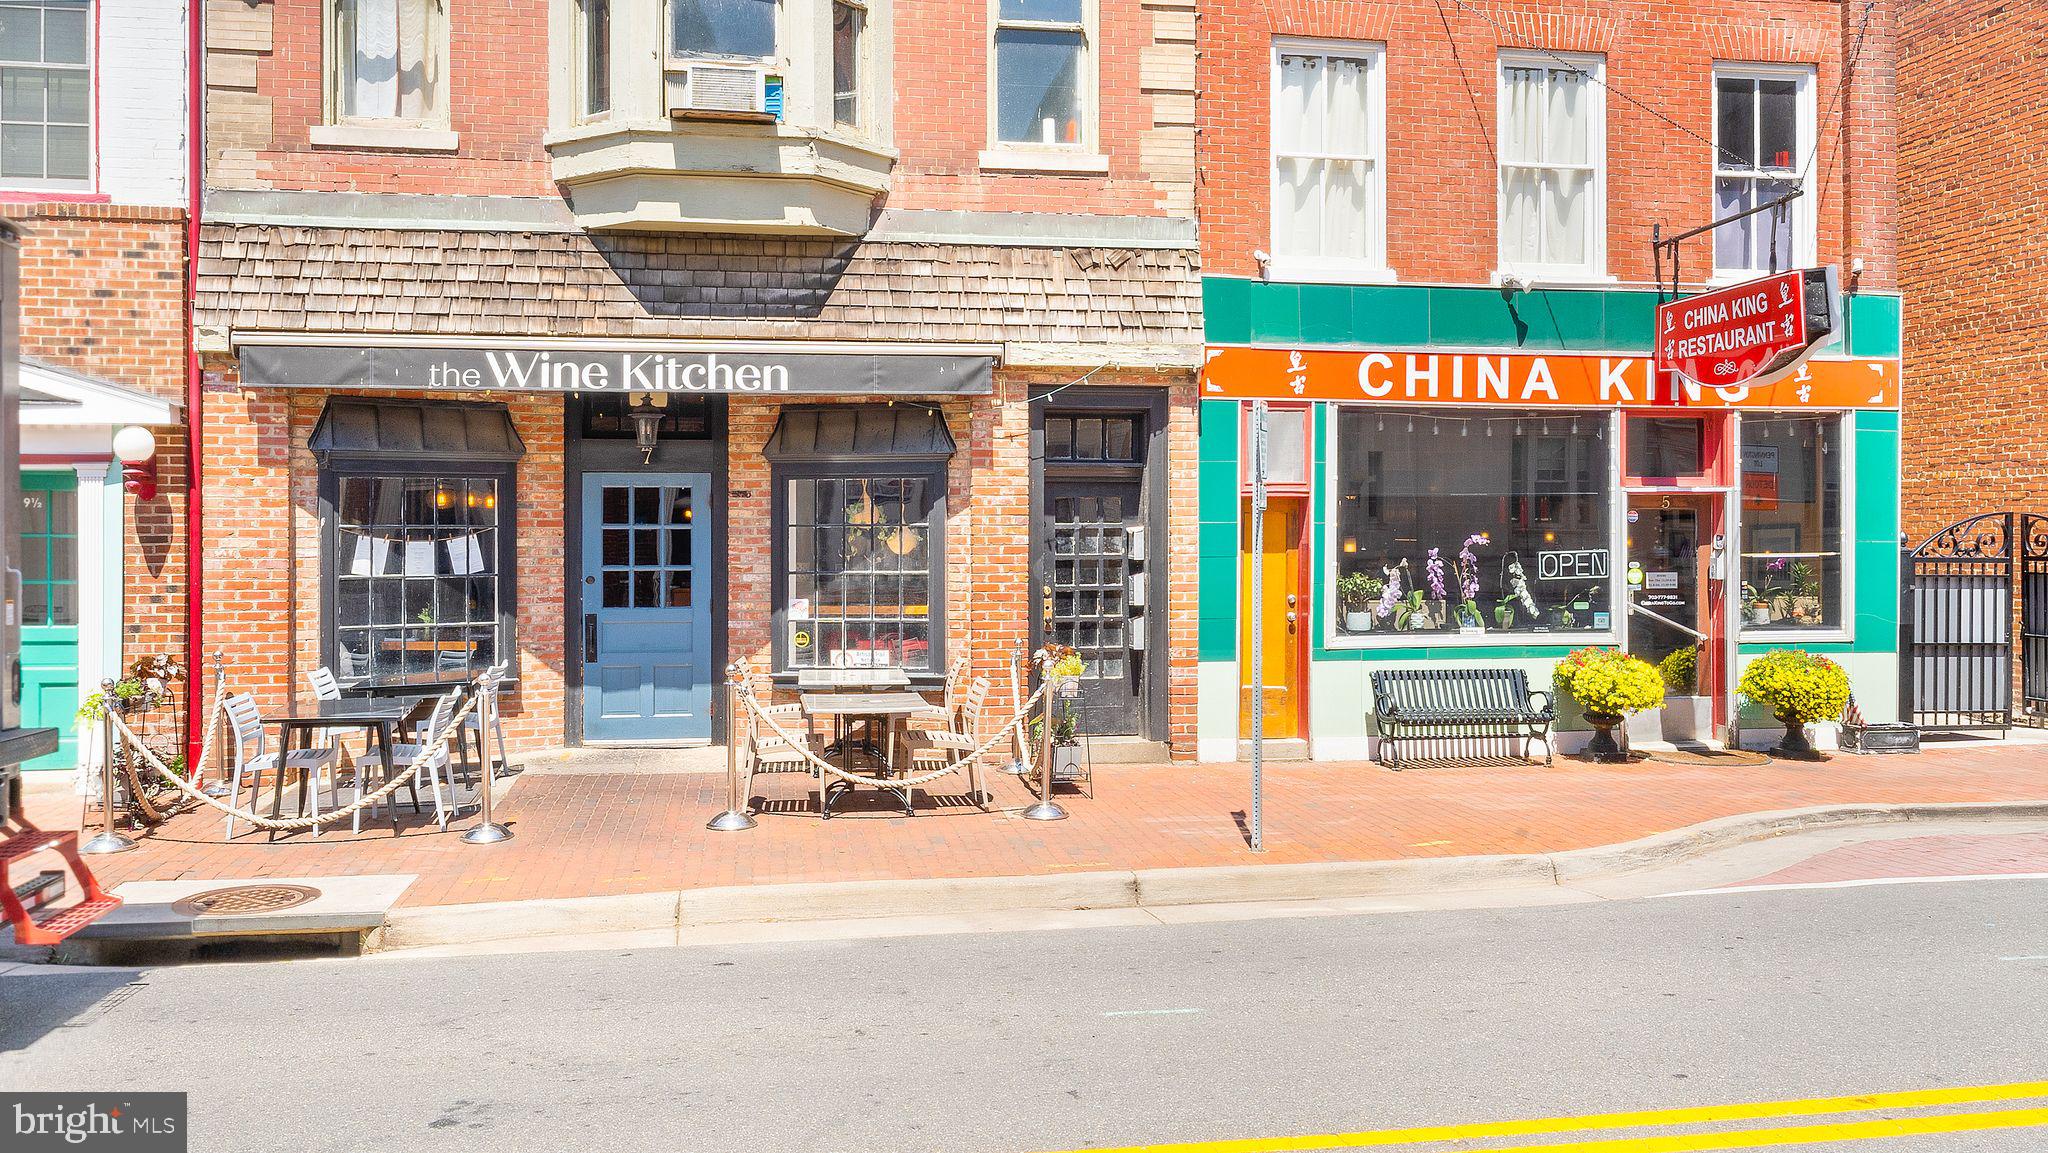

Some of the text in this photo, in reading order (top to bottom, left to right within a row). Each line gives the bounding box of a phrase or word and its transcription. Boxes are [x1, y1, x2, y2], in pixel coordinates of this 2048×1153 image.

[1684, 292, 1768, 330] CHINA KING
[1678, 320, 1776, 359] RESTAURANT
[429, 352, 789, 391] the Wine Kitchen
[1358, 353, 1560, 401] CHINA
[641, 447, 652, 464] 7
[1660, 495, 1670, 509] 5
[1541, 553, 1608, 578] OPEN
